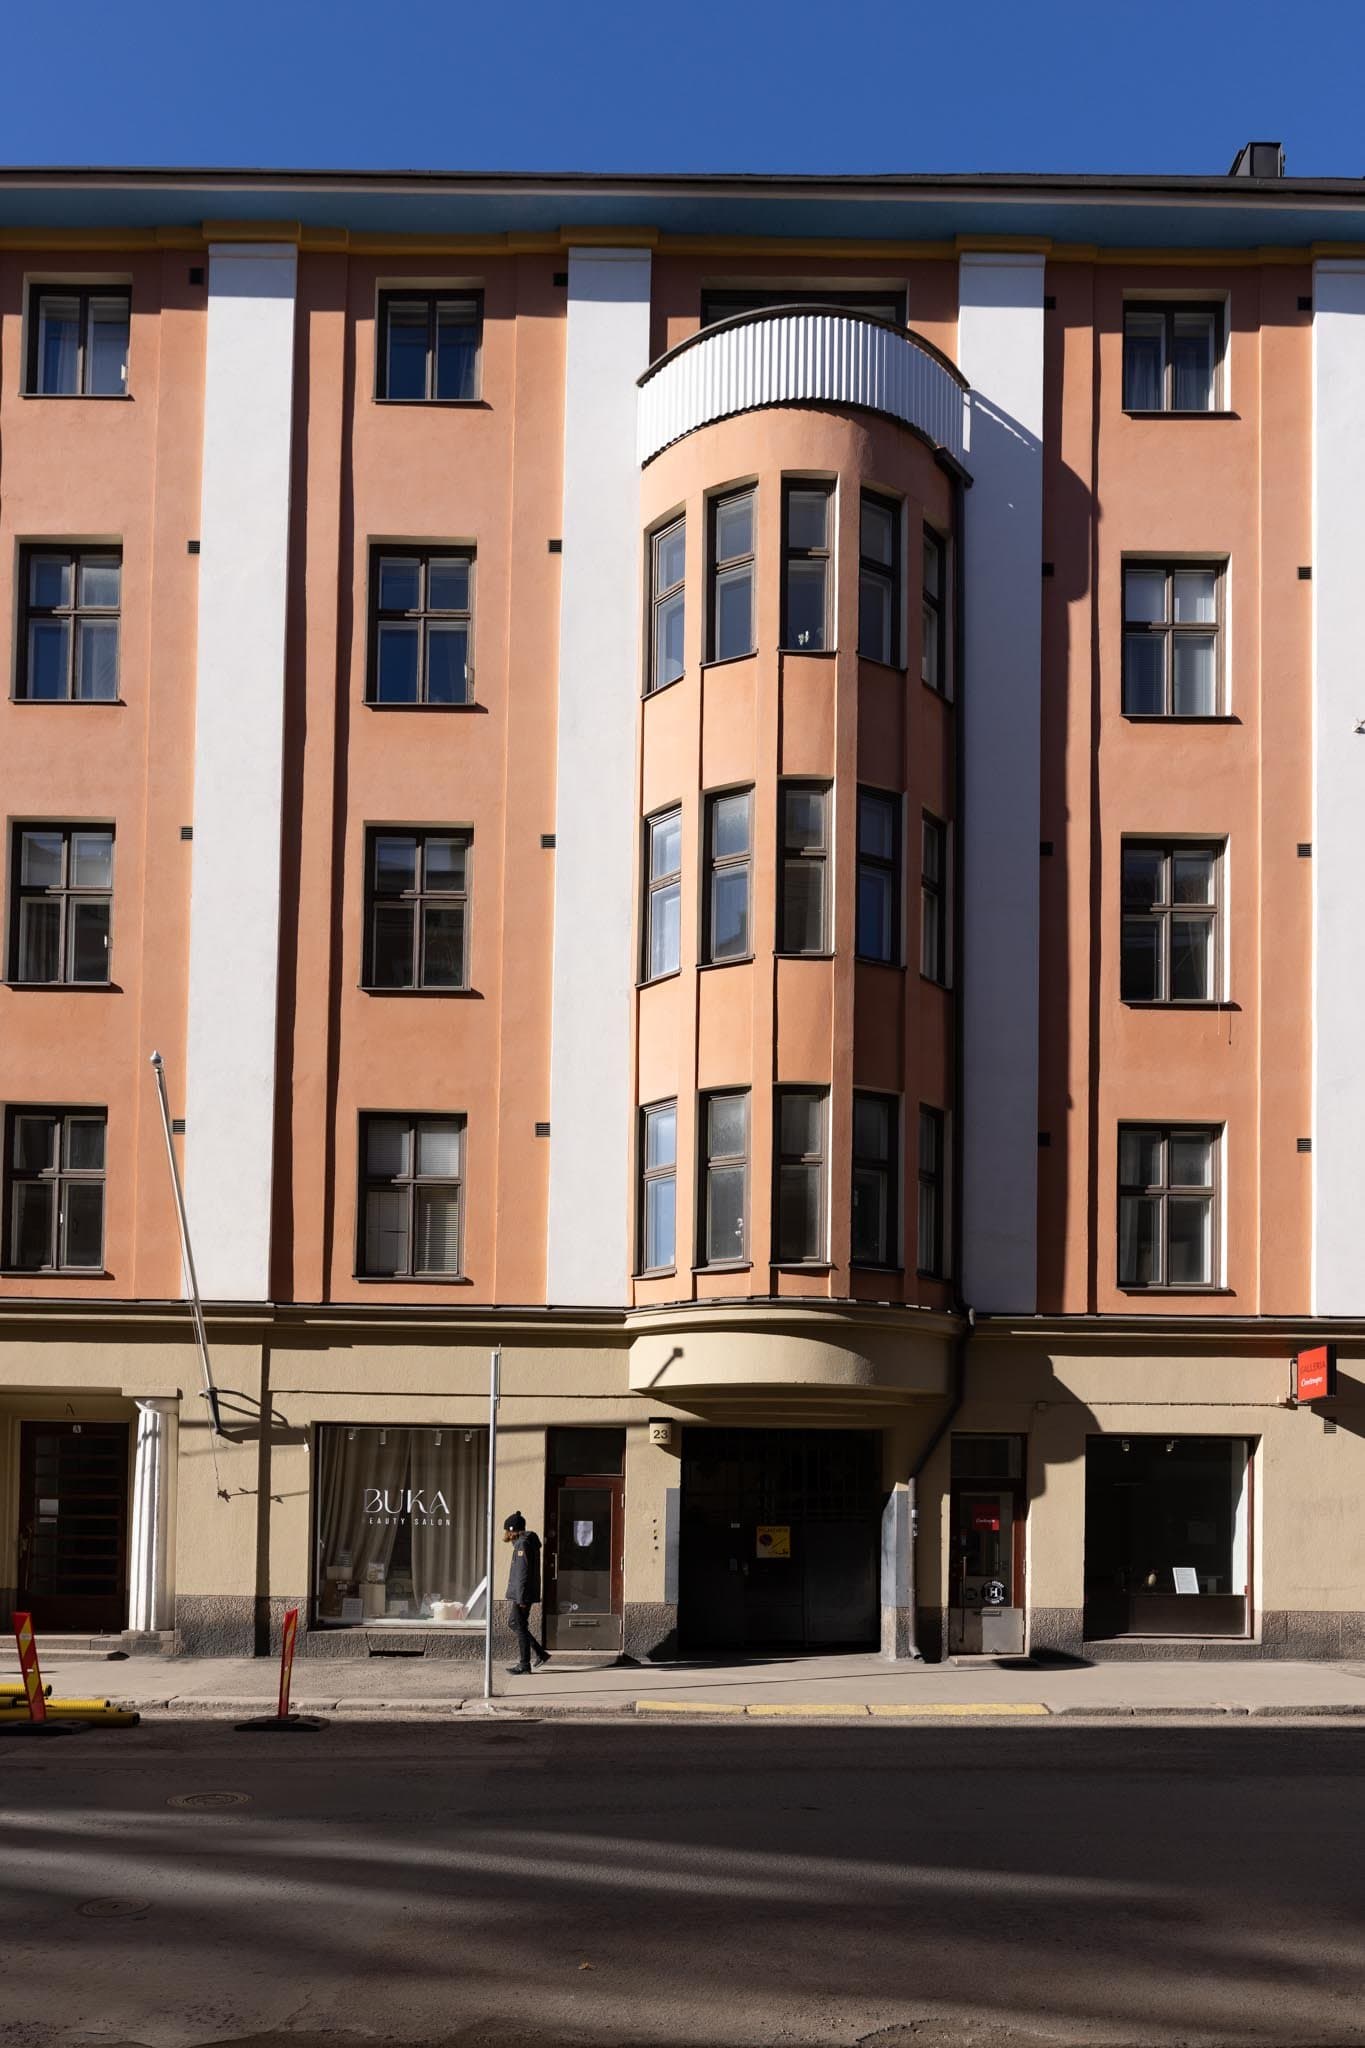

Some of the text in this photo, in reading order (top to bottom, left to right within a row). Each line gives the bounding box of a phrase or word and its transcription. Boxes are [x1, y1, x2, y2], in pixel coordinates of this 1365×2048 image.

[653, 1429, 668, 1440] 23
[364, 1488, 450, 1514] BUKA
[363, 1517, 450, 1526] EAUTY SALON
